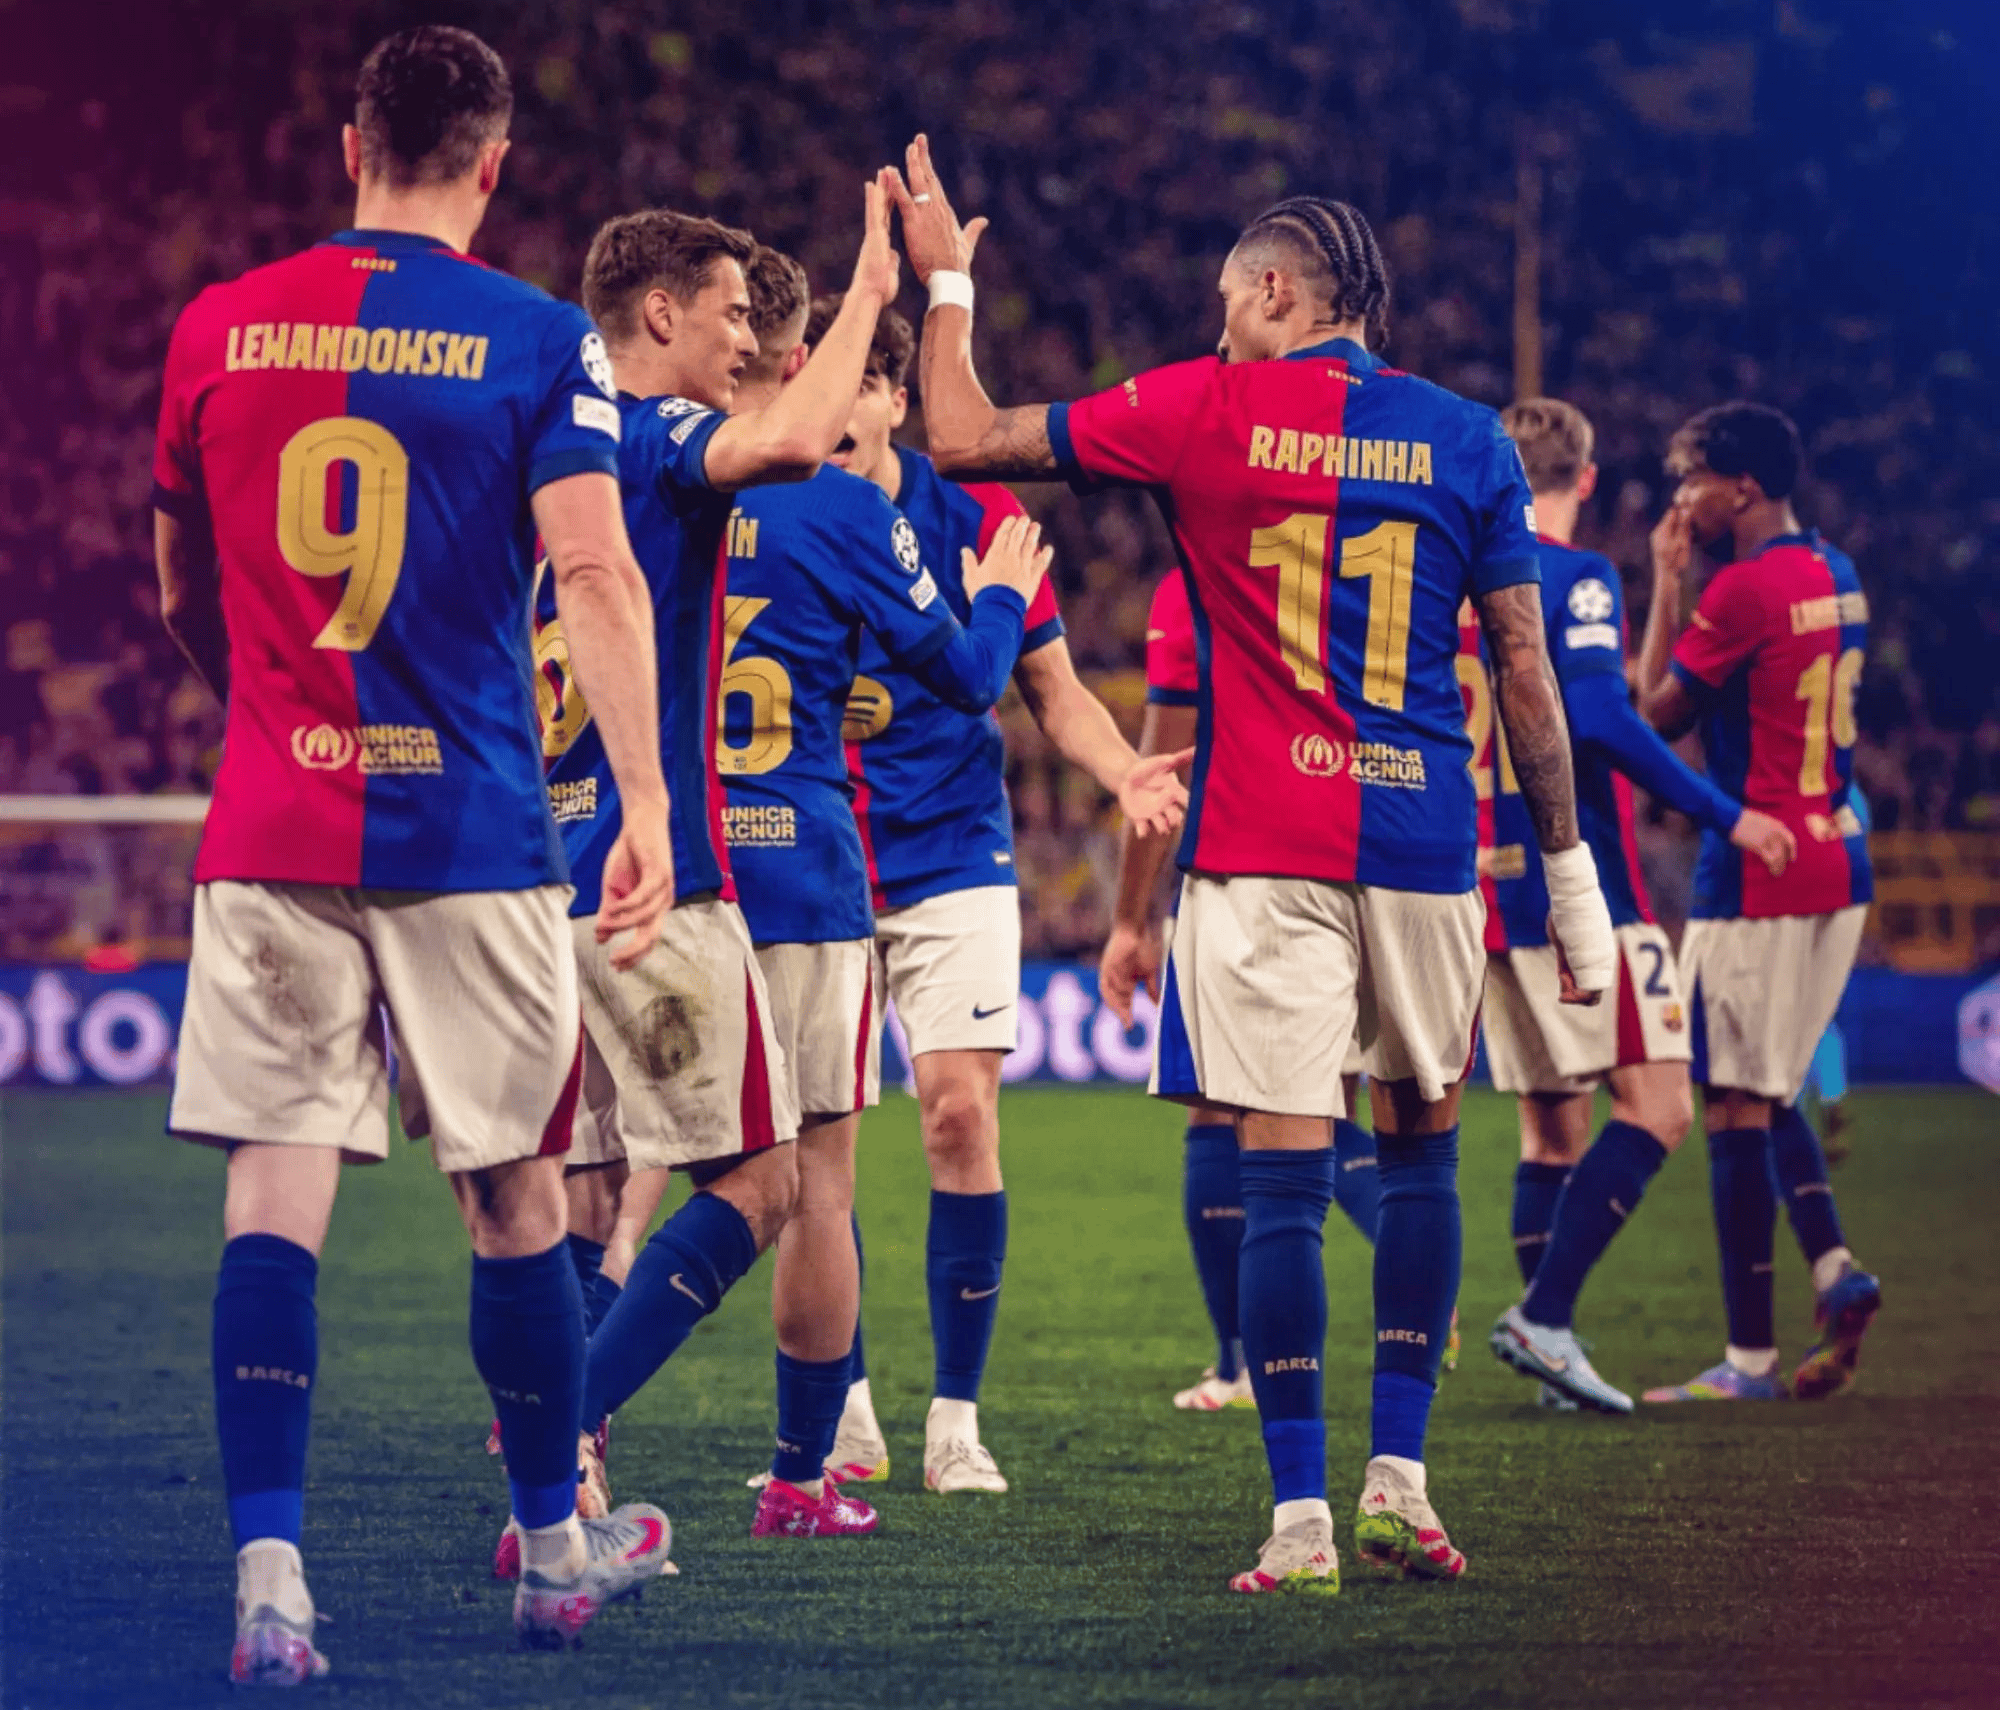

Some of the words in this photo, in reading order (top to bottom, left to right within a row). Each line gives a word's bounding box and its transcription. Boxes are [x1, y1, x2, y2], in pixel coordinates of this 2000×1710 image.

[225, 322, 489, 381] LEWANDOWSKI
[1247, 424, 1433, 486] RAPHINHA
[276, 416, 410, 652] 9
[726, 506, 759, 559] ÍN
[1248, 512, 1419, 713] 11
[353, 724, 438, 747] UNHCR
[357, 745, 442, 767] ACNUR
[1347, 758, 1425, 781] ACNUR
[546, 776, 597, 800] NHCR
[549, 796, 597, 818] CNUR
[720, 806, 795, 822] UNHCR
[722, 822, 795, 840] ACNUR
[1638, 942, 1671, 997] 2
[0, 972, 171, 1086] to
